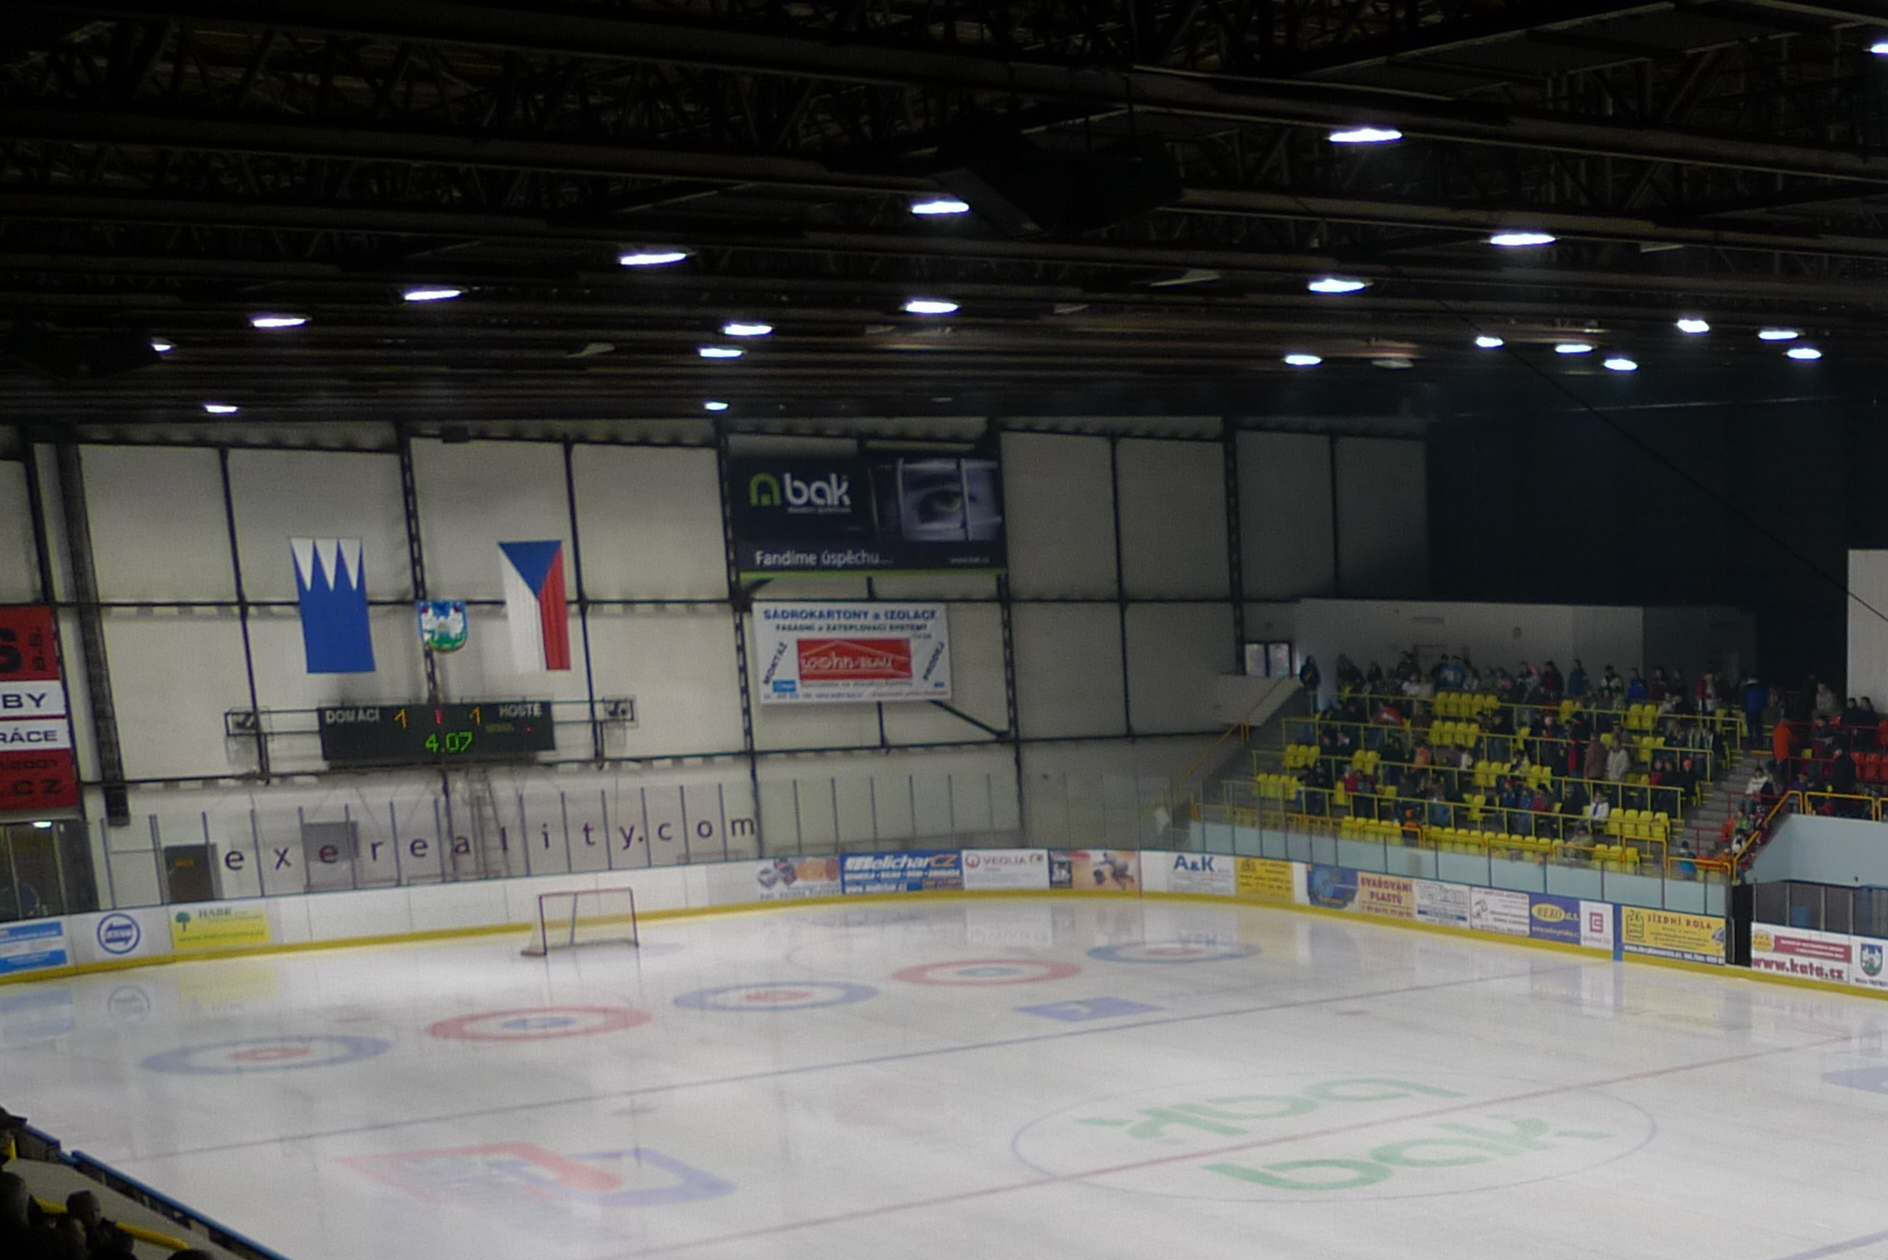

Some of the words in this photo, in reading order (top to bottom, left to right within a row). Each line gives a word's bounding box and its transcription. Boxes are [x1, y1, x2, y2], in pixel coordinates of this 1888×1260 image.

[784, 472, 851, 506] bak
[755, 550, 818, 567] Fandíme
[884, 609, 937, 621] IZOLACE
[1173, 854, 1215, 873] A&K
[1647, 913, 1682, 926] JÍZDNÍ
[1752, 957, 1845, 980] www.kata.cz
